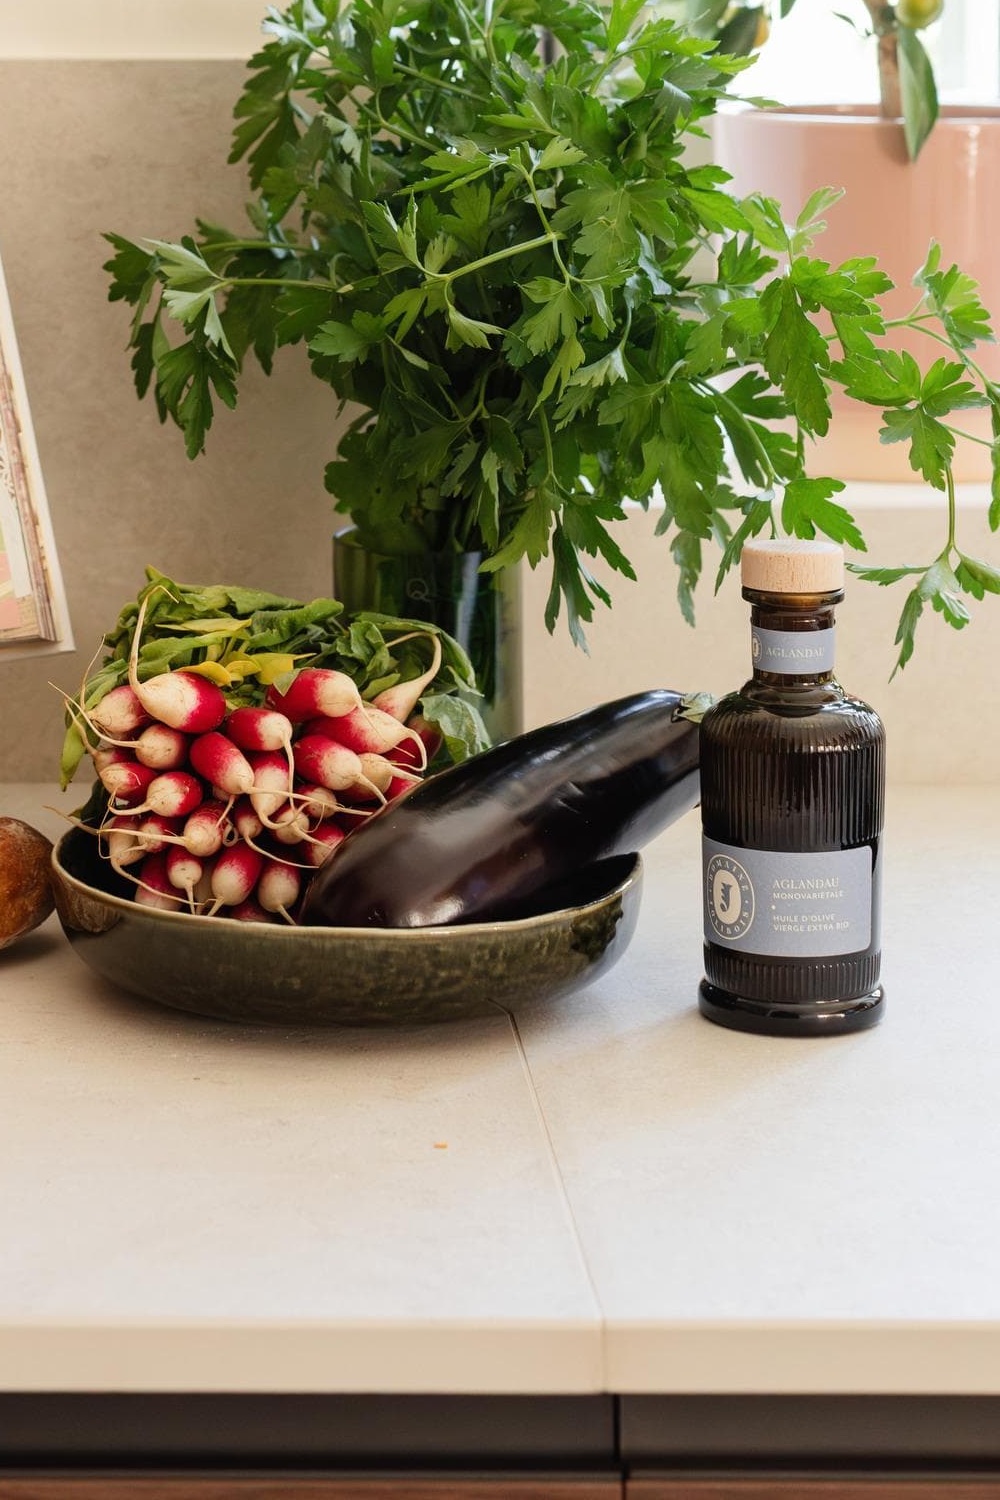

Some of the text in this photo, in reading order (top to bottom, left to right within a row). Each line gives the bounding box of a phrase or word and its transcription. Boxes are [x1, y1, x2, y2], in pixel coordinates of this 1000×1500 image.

[766, 646, 825, 658] AGLANDAU
[772, 877, 840, 890] AGLANDAU
[801, 913, 836, 922] D'OLIVE
[773, 924, 805, 932] VIERGE
[807, 922, 834, 932] EXTRA
